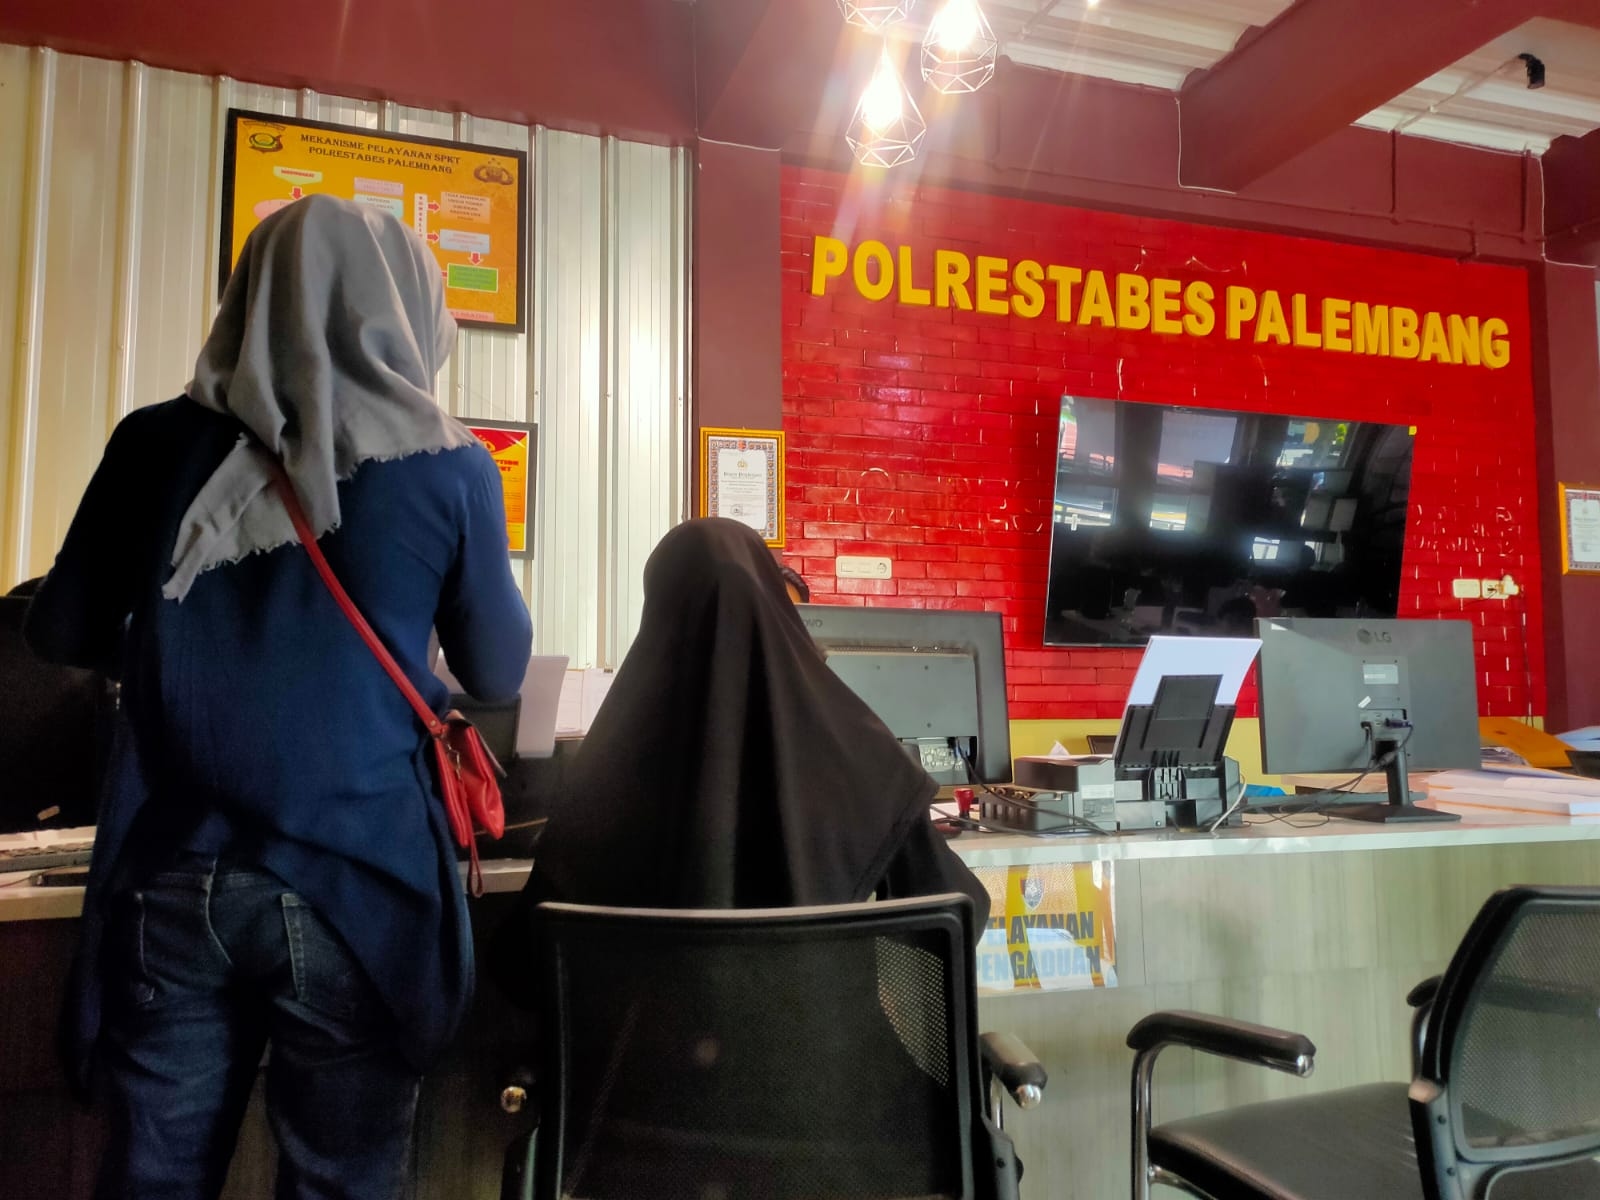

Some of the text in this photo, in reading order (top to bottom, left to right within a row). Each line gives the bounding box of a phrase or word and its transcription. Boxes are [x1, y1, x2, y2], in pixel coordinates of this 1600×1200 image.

[301, 134, 461, 165] MEKANISME PELAYANAN SPKT
[308, 146, 452, 174] POLRESTABES PALEMBANG
[811, 235, 1510, 369] POLRESTABES PALEMBANG
[1373, 631, 1392, 643] LG
[985, 911, 1094, 945] ELAYANAN
[976, 945, 1101, 982] ENGADUAN
